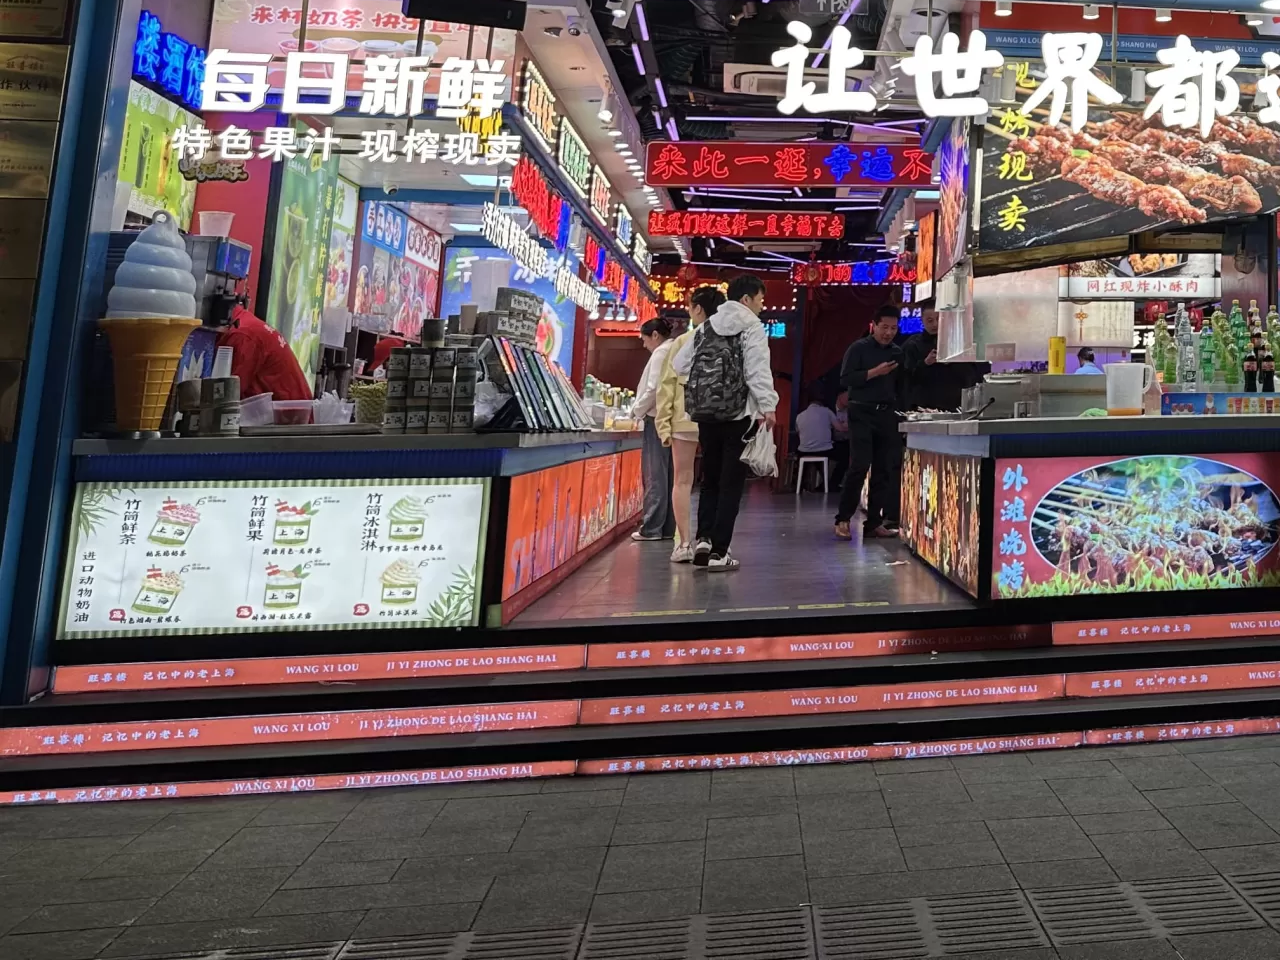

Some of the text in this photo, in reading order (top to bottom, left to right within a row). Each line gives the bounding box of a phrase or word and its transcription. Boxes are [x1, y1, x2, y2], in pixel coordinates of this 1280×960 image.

[201, 48, 507, 119] 每日新鲜
[172, 122, 341, 164] 特色果汁
[357, 127, 522, 167] 现榨现卖
[650, 212, 844, 238] 让我们就这样一直幸福下去
[1086, 279, 1199, 294] 网红现炸小酥肉
[119, 498, 142, 546] 竹筒鲜茶
[246, 494, 269, 542] 竹筒鲜果
[360, 492, 384, 552] 竹筒冰淇淋
[999, 463, 1029, 591] 外滩烧烤
[74, 551, 97, 623] 进口动物奶油
[87, 653, 557, 683] 旺喜楼 记忆中的老上海 WANG XI LOU JI YI ZHONG DE LAO SHANG HAI
[608, 683, 1038, 715] 旺喜楼 记忆中的老上海 WANG XI LOU JI YI ZHONG DE LAO SHANG HAI
